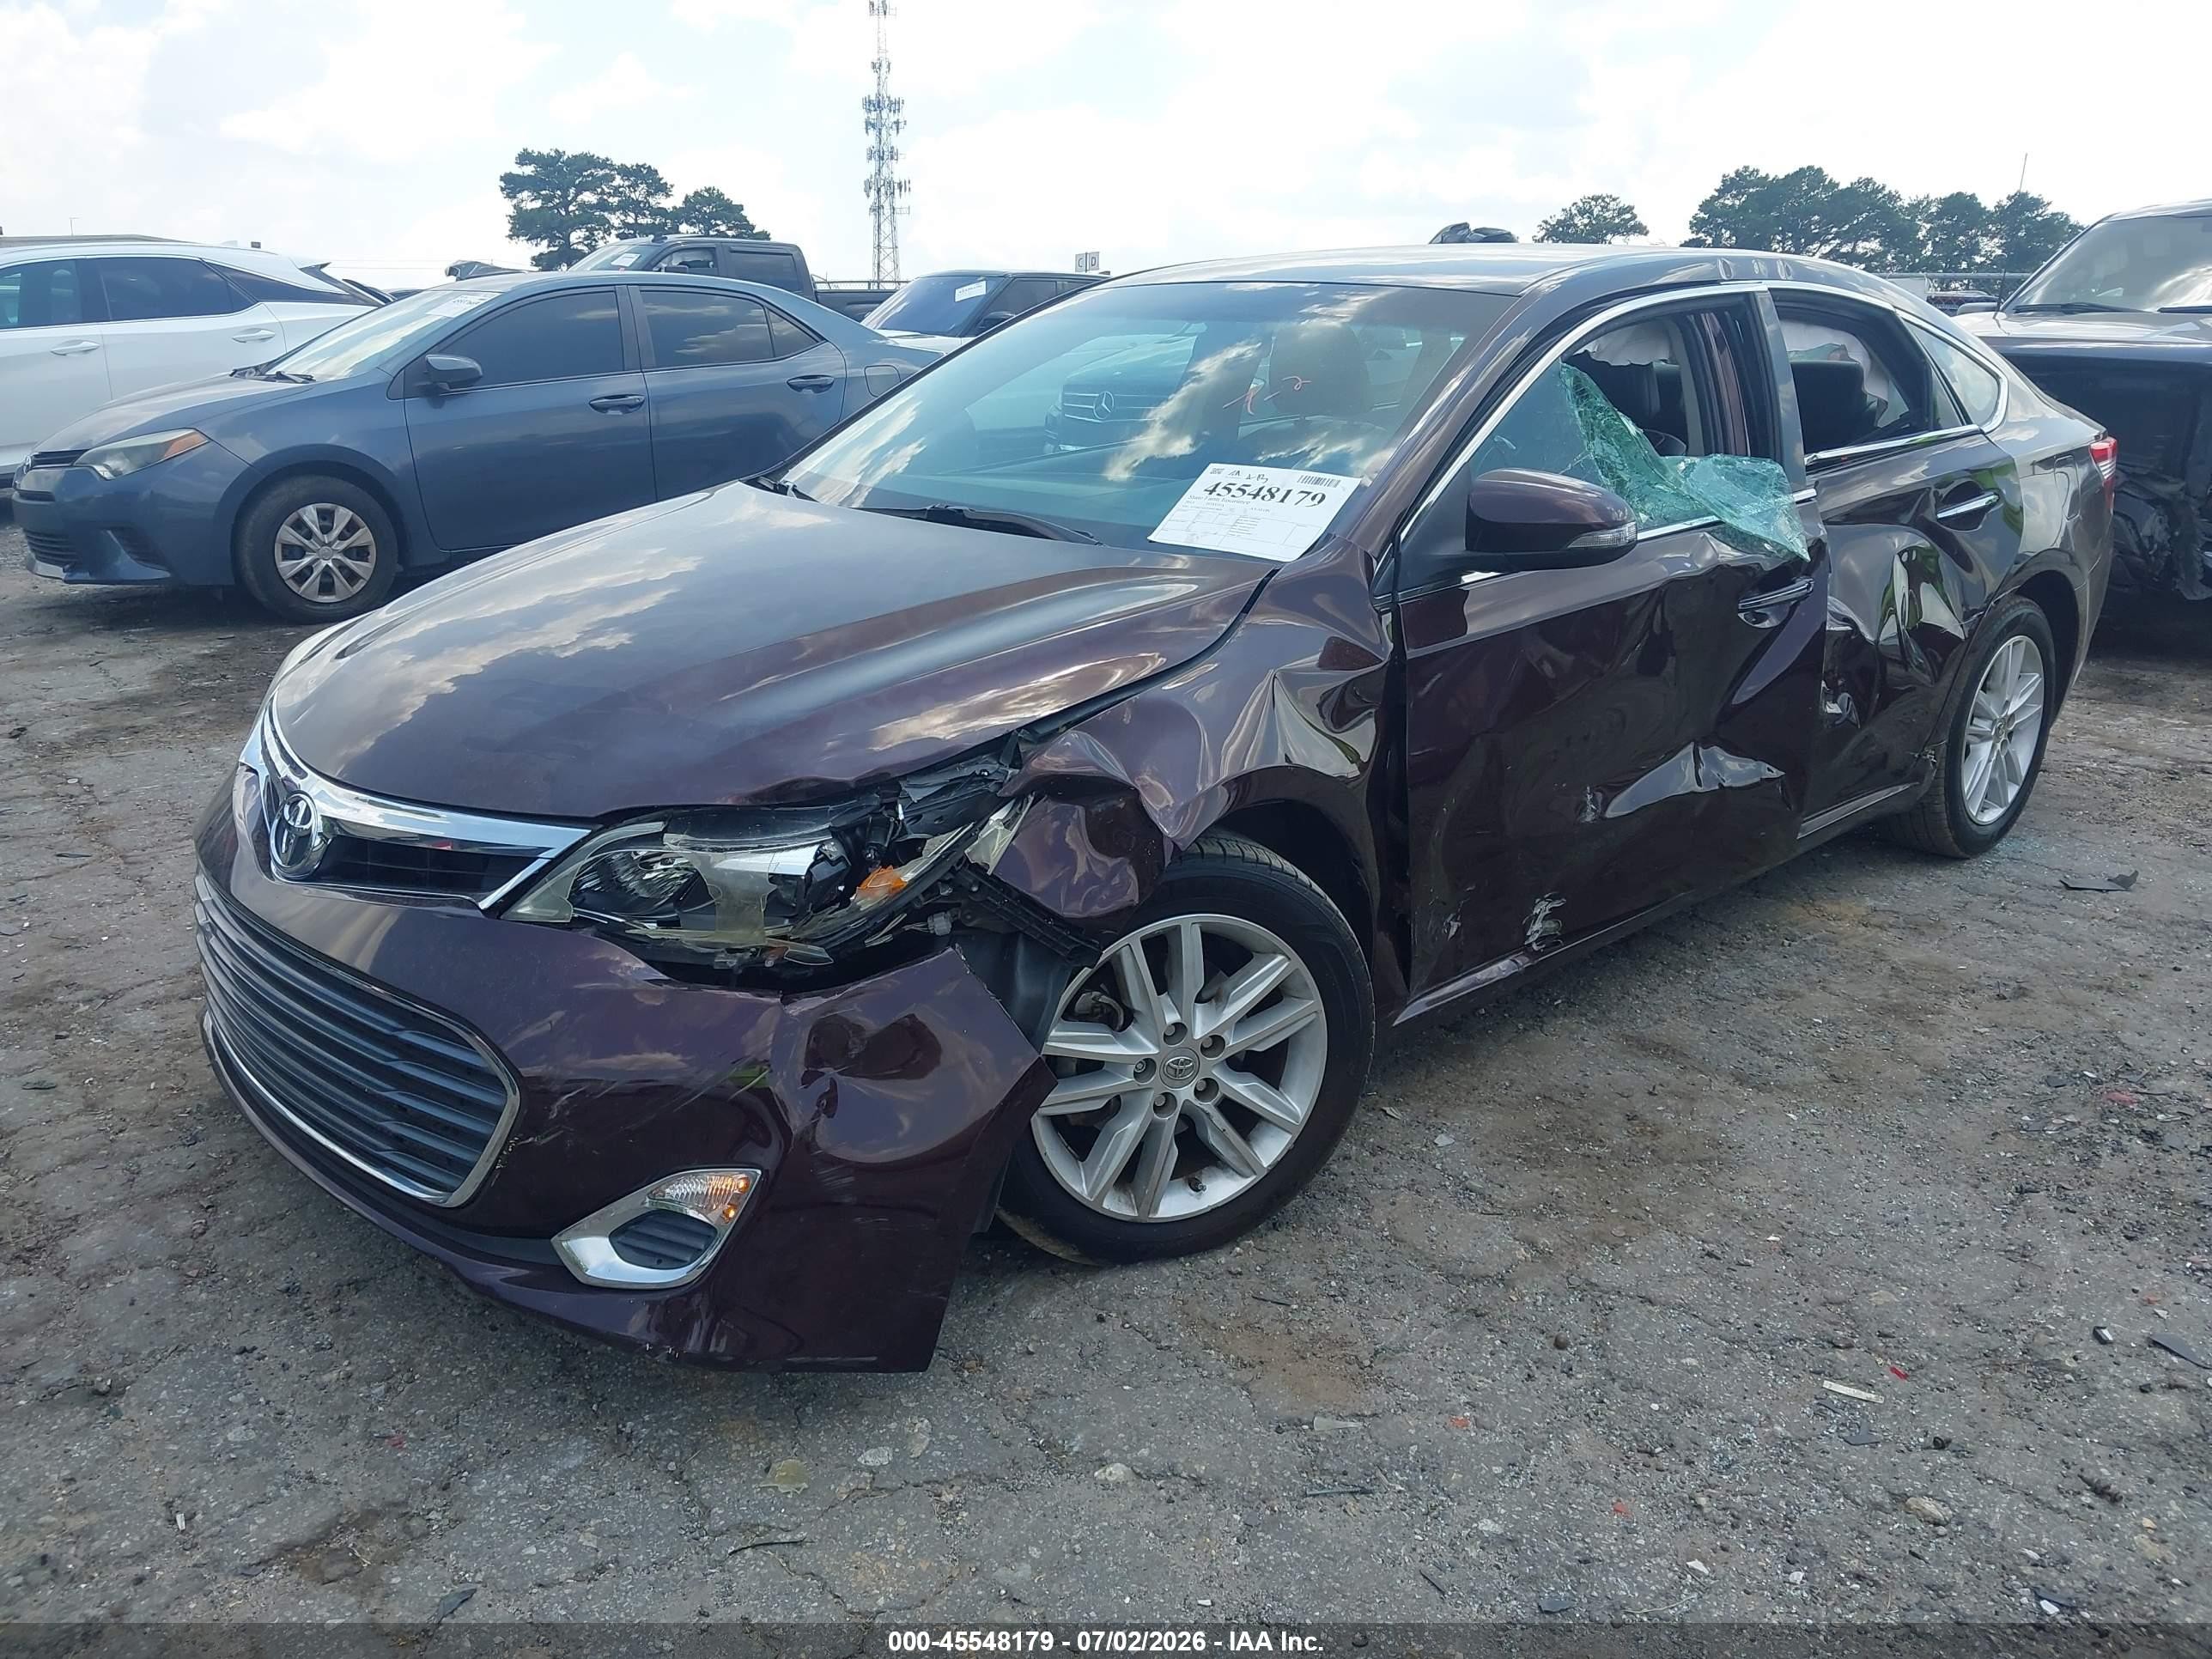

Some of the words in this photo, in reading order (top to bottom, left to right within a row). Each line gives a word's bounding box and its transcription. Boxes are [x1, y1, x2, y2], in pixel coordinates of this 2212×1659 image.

[1078, 258, 1084, 268] C
[1091, 256, 1097, 267] D
[1203, 481, 1327, 507] 45548179
